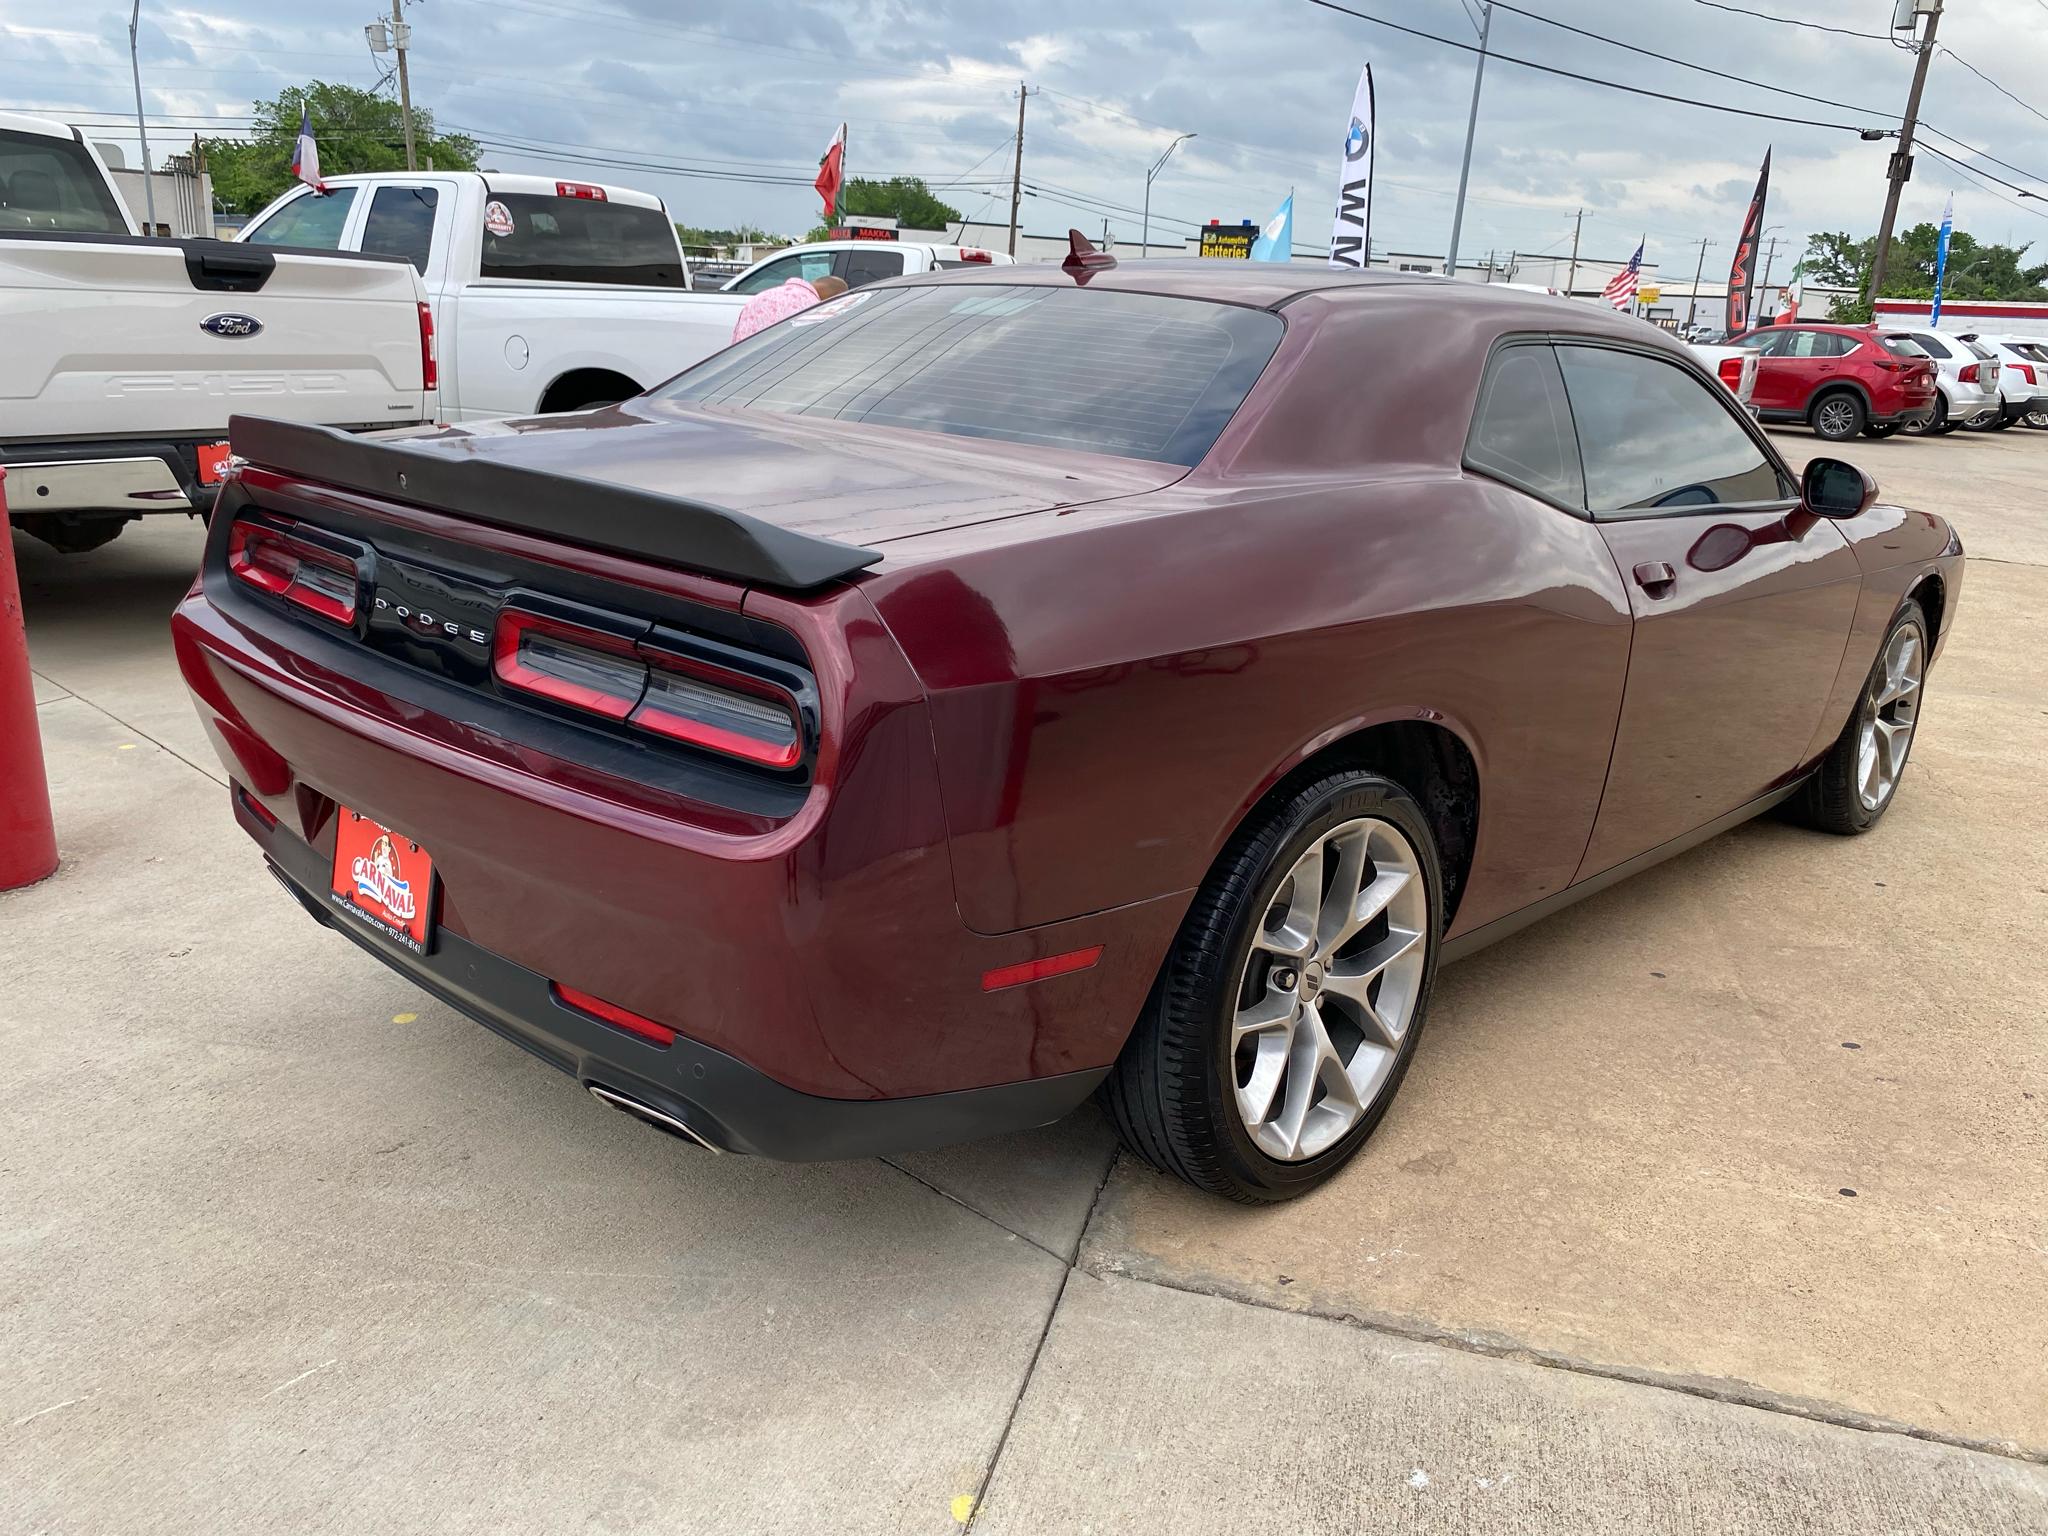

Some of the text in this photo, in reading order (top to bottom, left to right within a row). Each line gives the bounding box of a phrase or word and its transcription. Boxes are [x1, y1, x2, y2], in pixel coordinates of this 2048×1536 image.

[859, 228, 891, 239] MAKKA
[1218, 235, 1249, 245] Automotive
[1202, 245, 1247, 259] Batteries
[217, 317, 251, 334] Ford
[104, 374, 348, 399] F-150
[375, 598, 486, 644] DODGE
[353, 858, 415, 914] CARNAVAL
[331, 894, 421, 954] www.CarnavalAutos.com 972-241-8141
